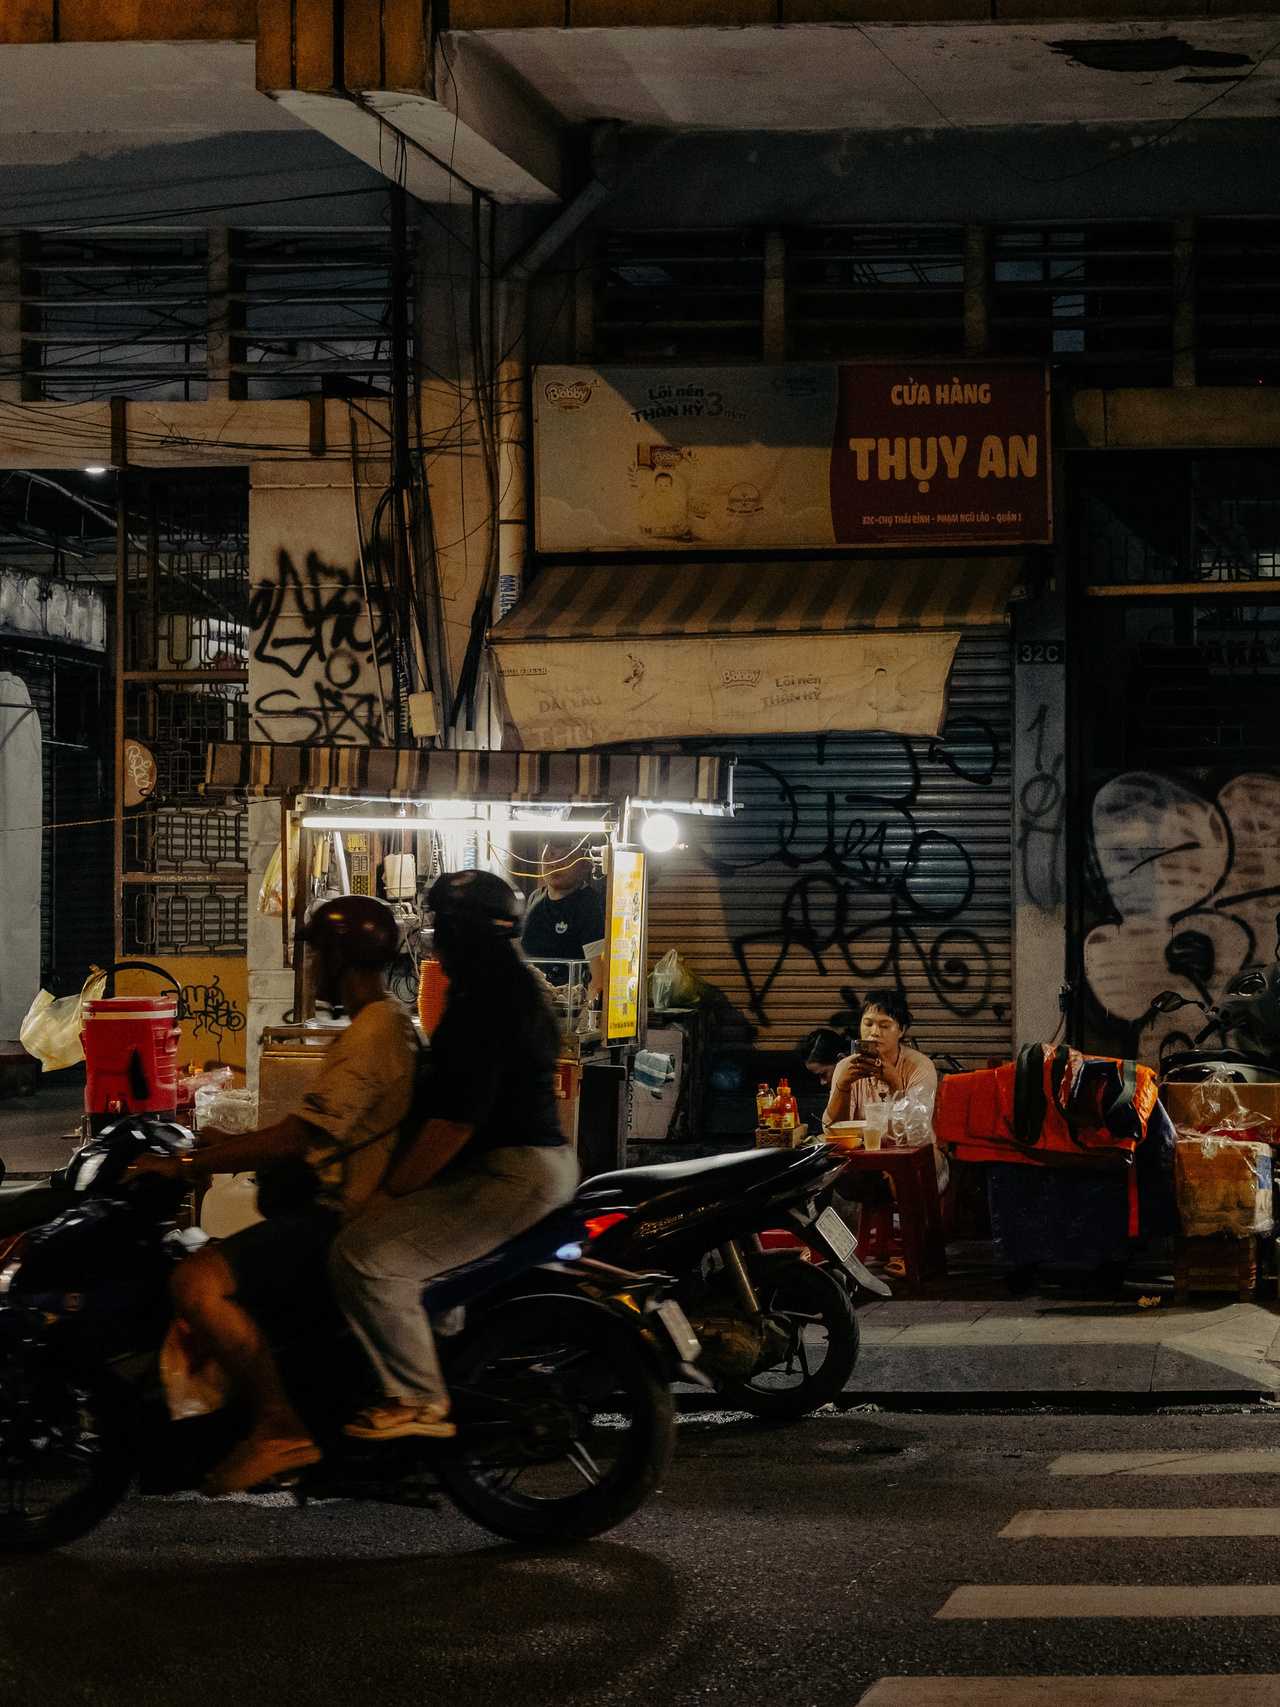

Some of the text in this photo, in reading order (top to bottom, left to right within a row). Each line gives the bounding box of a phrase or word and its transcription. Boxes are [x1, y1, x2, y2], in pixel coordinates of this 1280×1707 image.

[648, 384, 704, 400] Lõi nén
[891, 377, 991, 405] CỬA HÀNG
[631, 400, 679, 422] THẦN
[849, 434, 1038, 493] THỤY AN
[895, 512, 911, 524] THÁI
[913, 512, 931, 524] BÌNH
[937, 513, 959, 525] PHẠM
[960, 511, 975, 523] NGŨ
[976, 511, 990, 523] LÃO
[996, 510, 1017, 524] QUẬN
[1022, 644, 1059, 662] 32C
[522, 667, 547, 676] FRESH
[774, 674, 822, 688] Lõi nén
